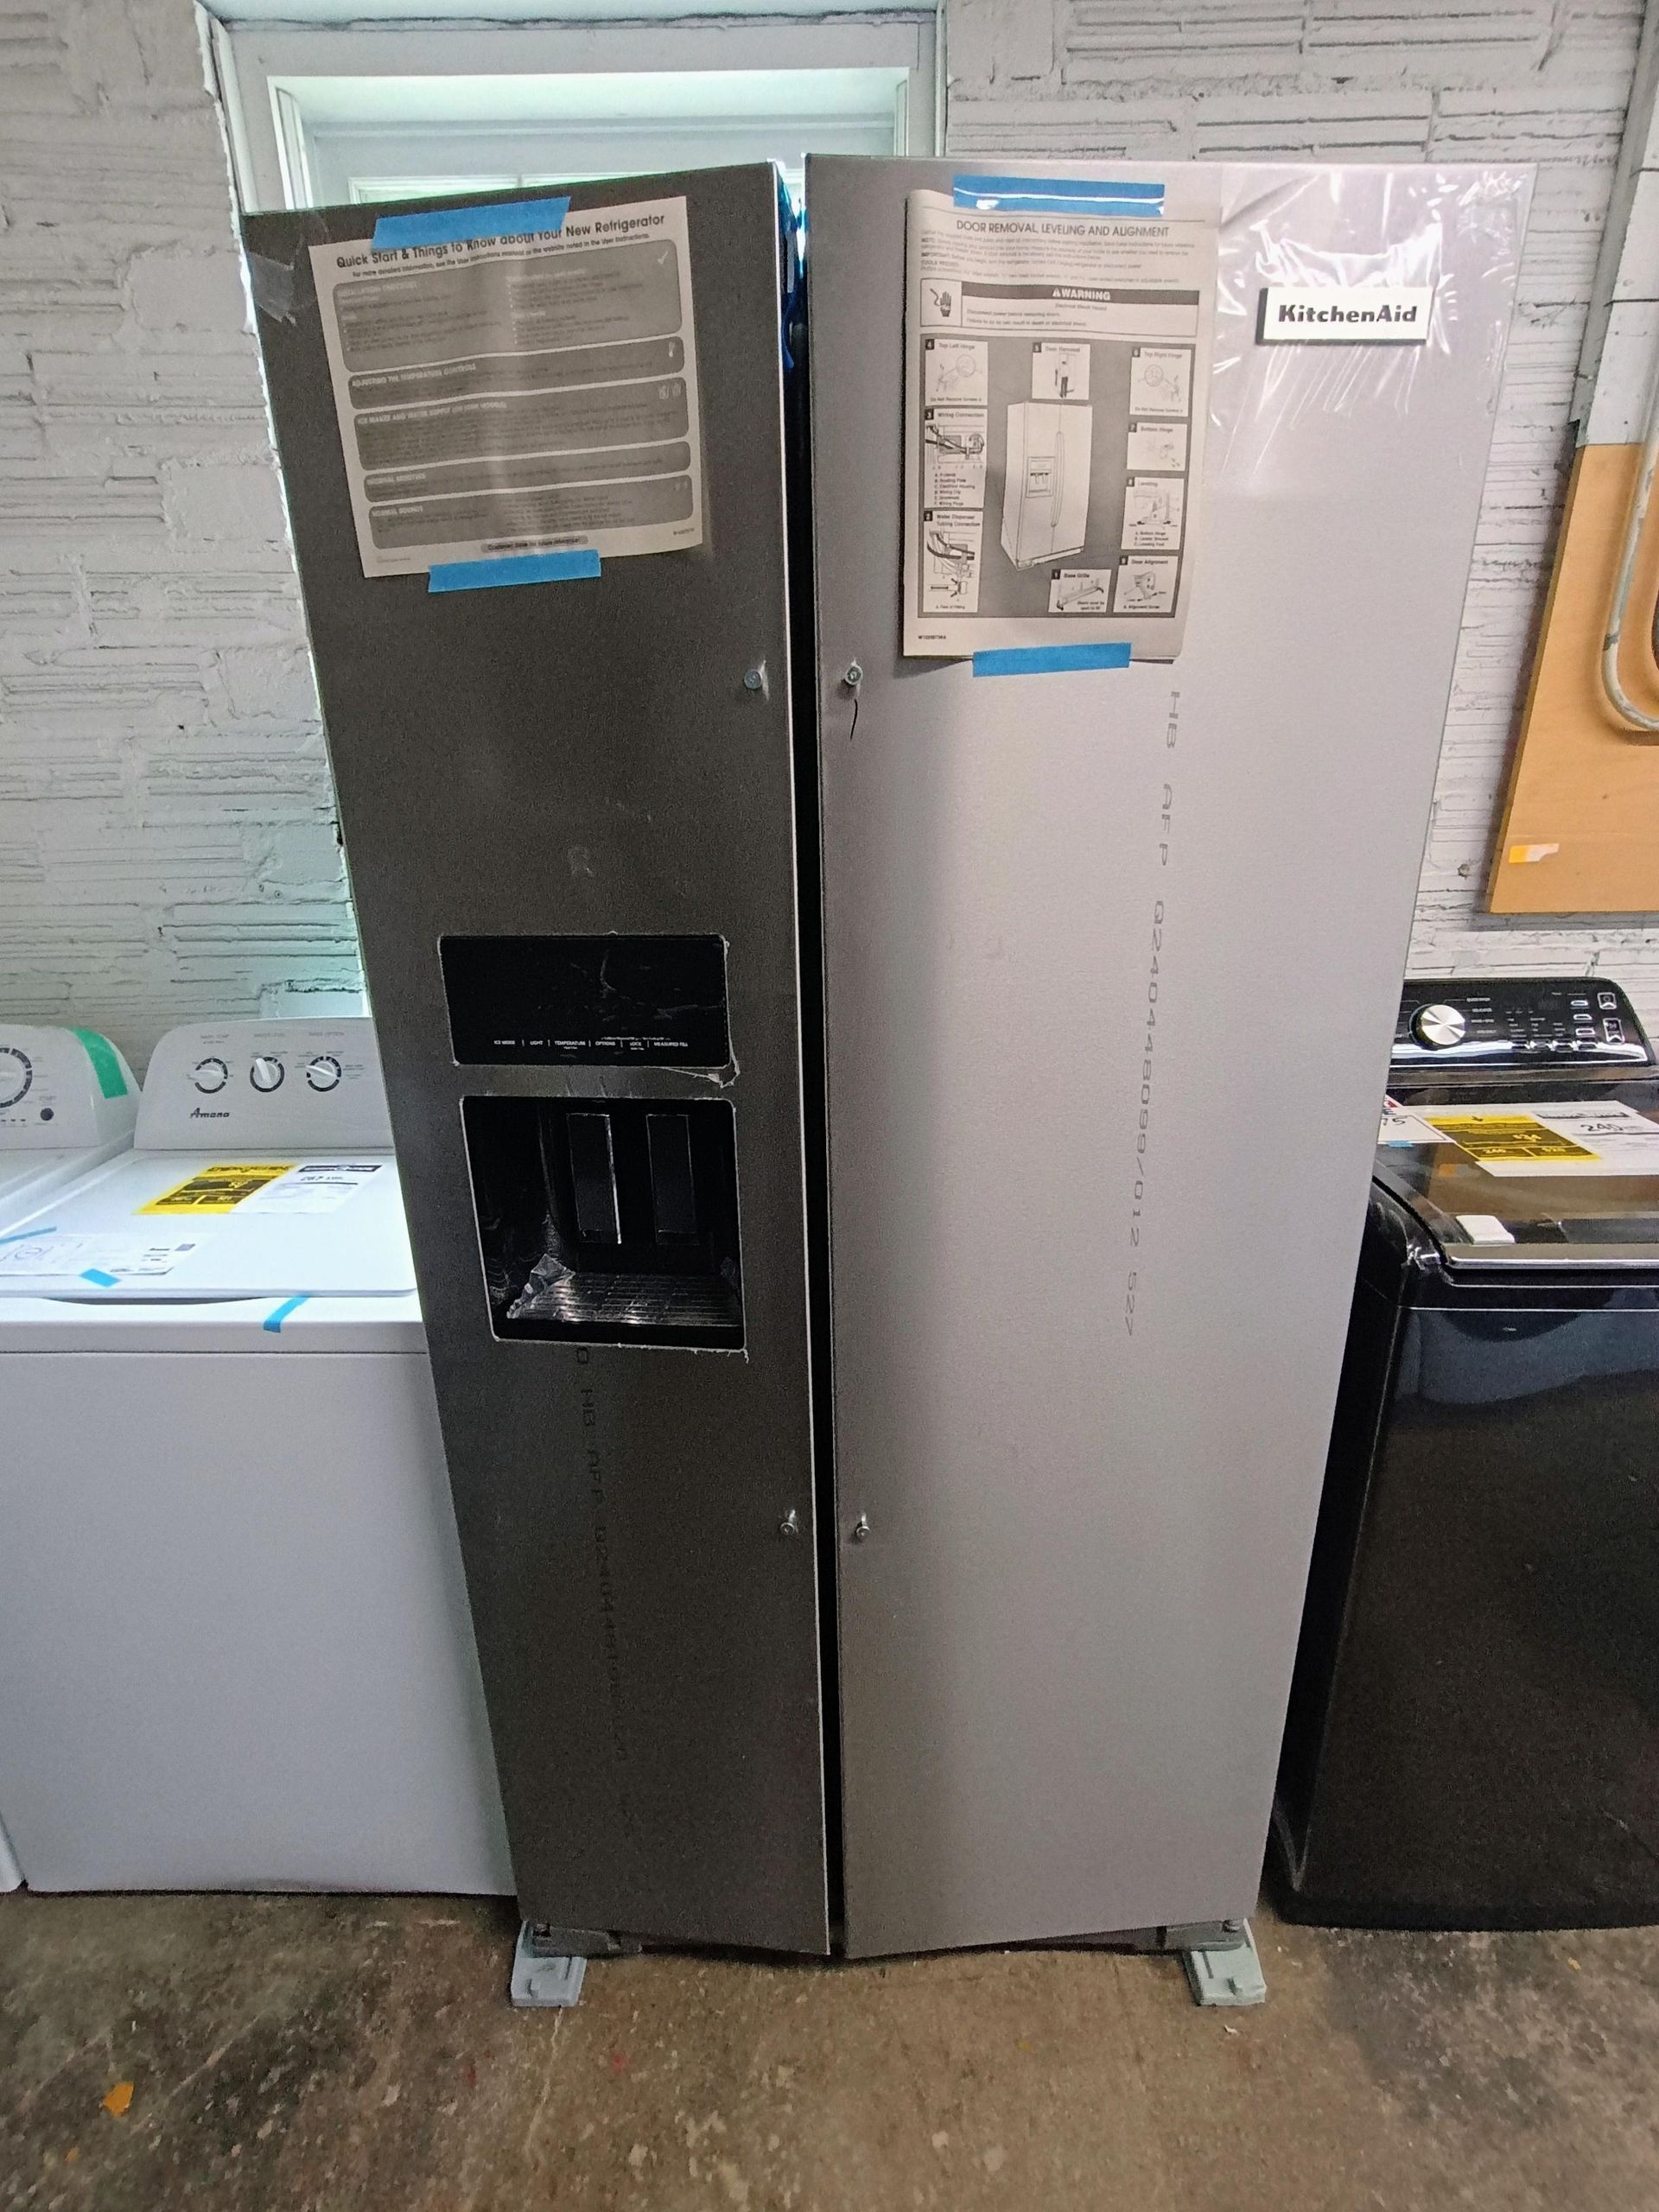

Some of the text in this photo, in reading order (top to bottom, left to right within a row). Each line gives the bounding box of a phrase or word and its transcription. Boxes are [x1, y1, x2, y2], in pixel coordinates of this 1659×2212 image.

[957, 220, 986, 232] DOOR
[1041, 224, 1085, 235] LEVELING
[1088, 226, 1110, 236] AND
[1112, 226, 1169, 237] ALIGNMENT
[337, 254, 368, 268] Quick
[372, 251, 397, 264] Start
[402, 248, 410, 259] &
[412, 245, 448, 258] Things
[452, 243, 463, 253] to
[467, 238, 496, 251] Know
[566, 226, 591, 237] New
[595, 215, 665, 233] Refrigerator
[1062, 288, 1111, 301] WARNING
[1279, 305, 1417, 322] KitchenAid
[1166, 691, 1180, 749] HB
[1159, 783, 1173, 866] AFP
[189, 1107, 231, 1119] Amana
